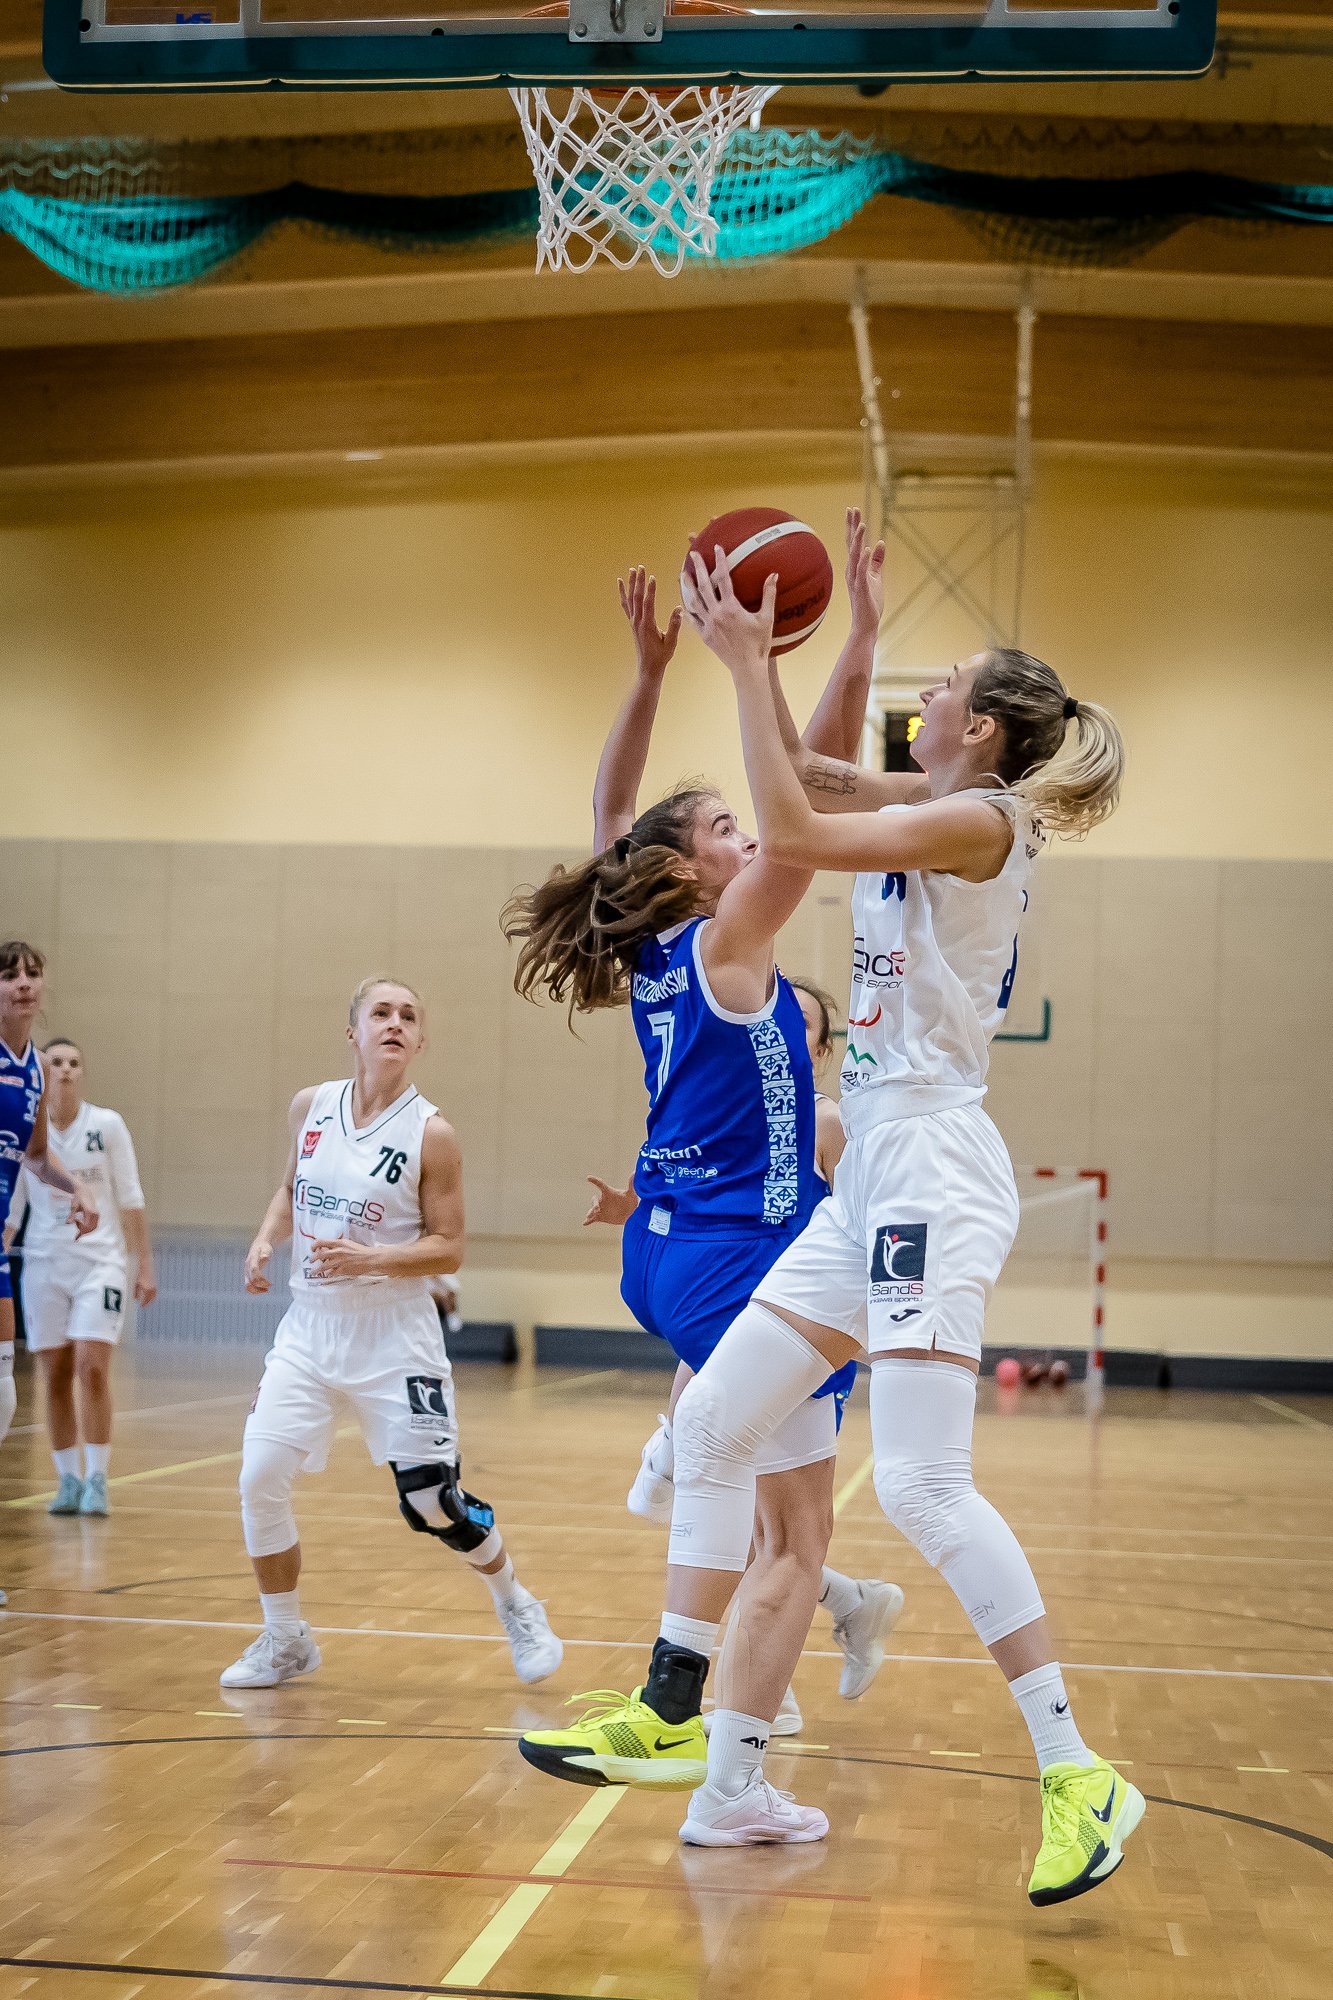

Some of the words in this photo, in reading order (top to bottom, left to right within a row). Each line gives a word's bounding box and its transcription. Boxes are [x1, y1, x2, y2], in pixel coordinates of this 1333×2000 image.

[647, 1011, 675, 1102] 7
[369, 1146, 408, 1185] 76
[300, 1185, 385, 1223] iSandS
